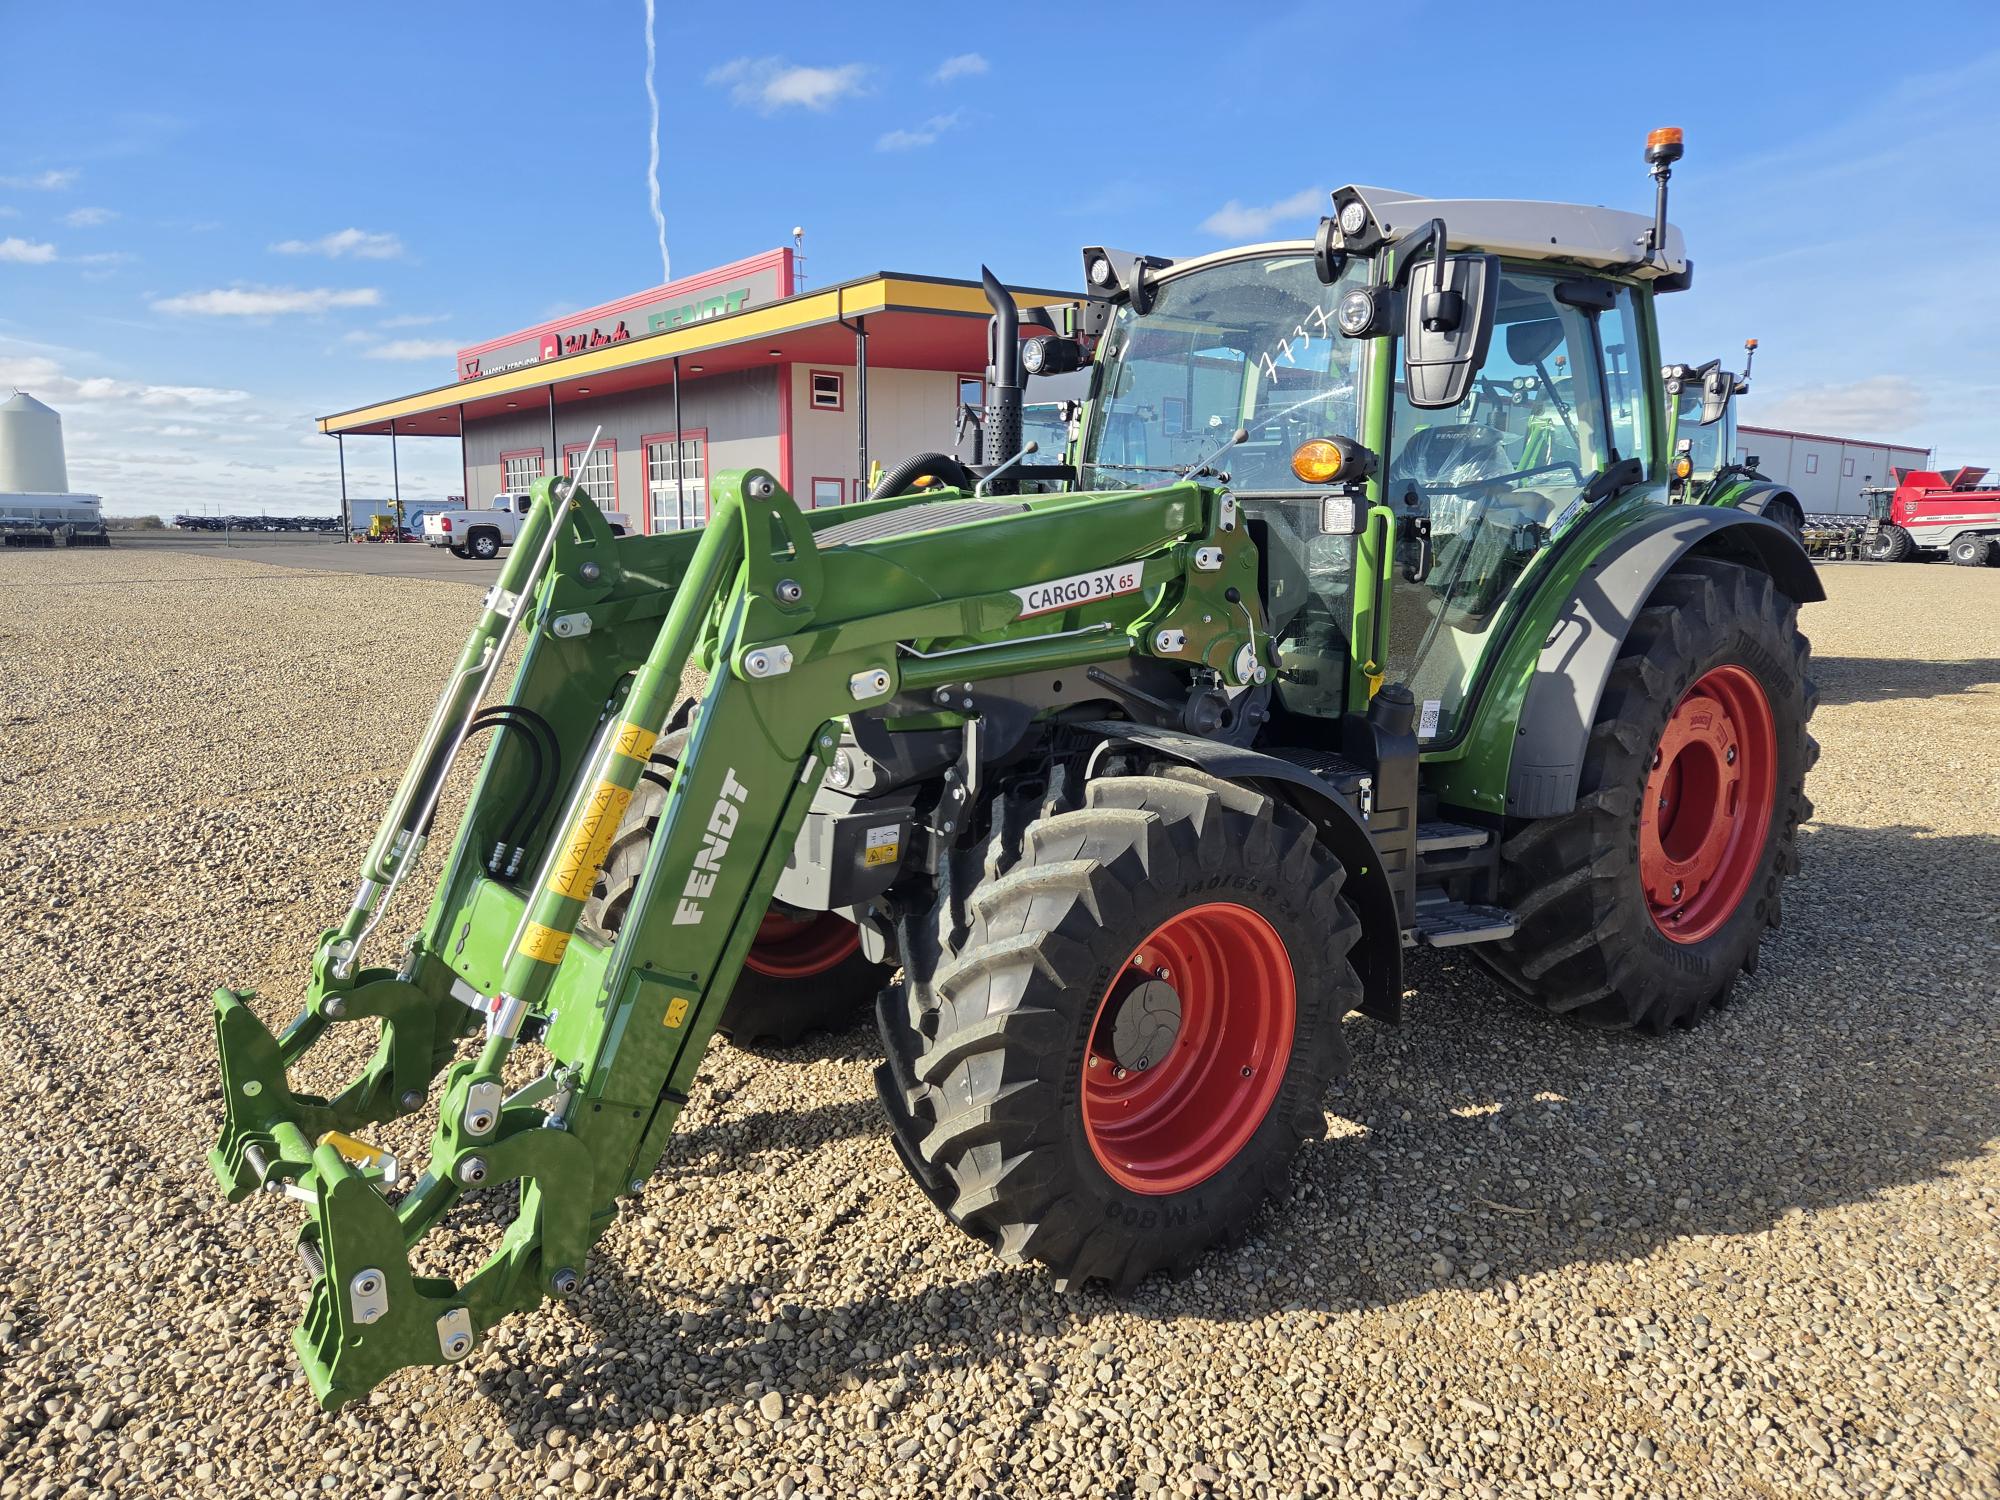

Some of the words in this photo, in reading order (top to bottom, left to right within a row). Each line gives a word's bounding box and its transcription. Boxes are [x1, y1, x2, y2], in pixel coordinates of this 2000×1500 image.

[1259, 305, 1337, 384] 7737
[1028, 580, 1091, 610] CARGO
[1094, 573, 1116, 595] 3X
[1119, 574, 1134, 589] 65
[672, 767, 749, 926] FENDT
